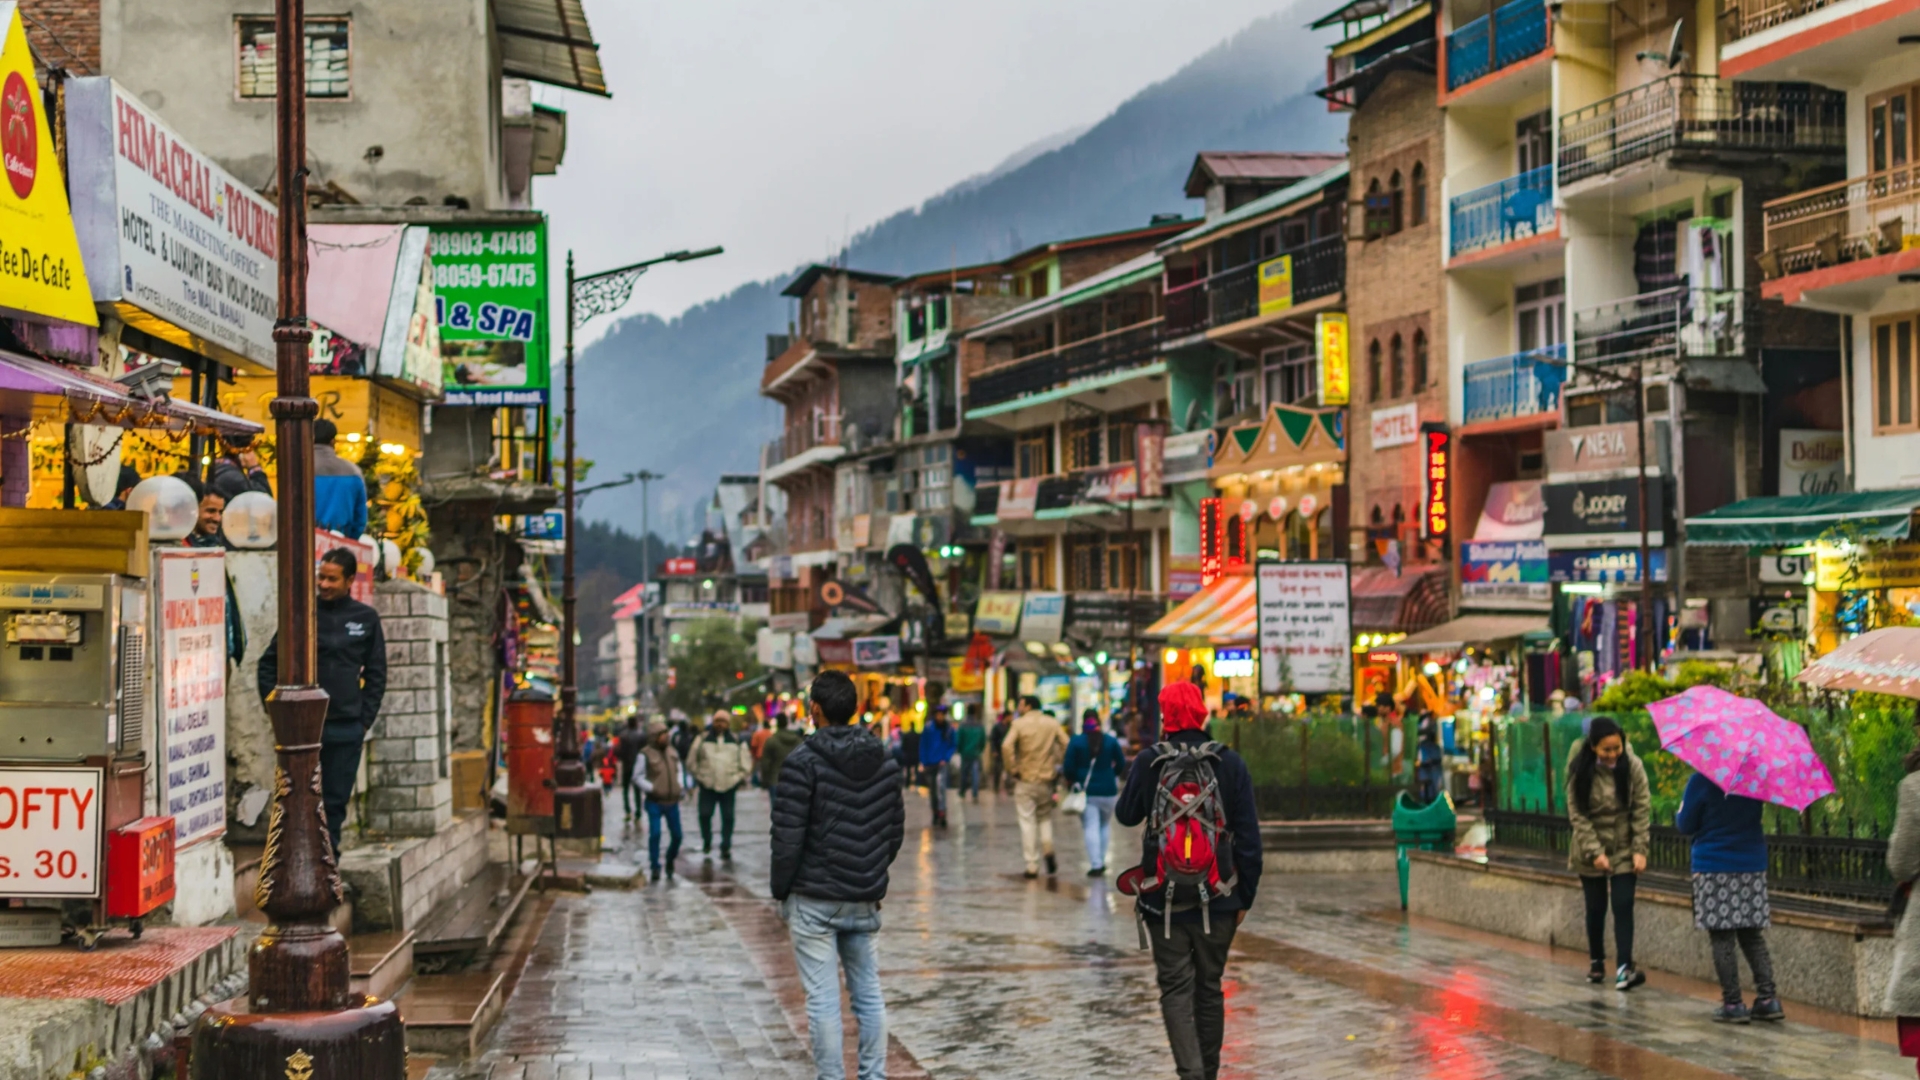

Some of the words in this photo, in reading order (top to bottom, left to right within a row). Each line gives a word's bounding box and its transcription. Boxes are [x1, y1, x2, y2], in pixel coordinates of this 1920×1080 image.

[116, 94, 215, 221] HIMACHAL
[150, 193, 171, 224] THE
[172, 209, 230, 262] MARKETING
[231, 249, 259, 280] OFFICE
[21, 247, 39, 282] De
[42, 253, 71, 291] Cafe
[122, 206, 156, 256] HOTEL
[161, 232, 168, 262] &
[170, 237, 205, 284] LUXURY
[206, 260, 223, 294] BUS
[225, 271, 249, 309] VOLVO
[182, 281, 196, 305] The
[198, 289, 218, 317] MALL
[219, 300, 246, 329] MANALI
[449, 302, 472, 327] &
[478, 303, 535, 341] SPA
[1374, 414, 1414, 439] HOTEL
[1585, 431, 1626, 456] NEVA
[1791, 440, 1841, 461] Dollar
[1800, 472, 1839, 496] Club
[1573, 552, 1637, 569] Gulati
[34, 850, 87, 879] 30.
